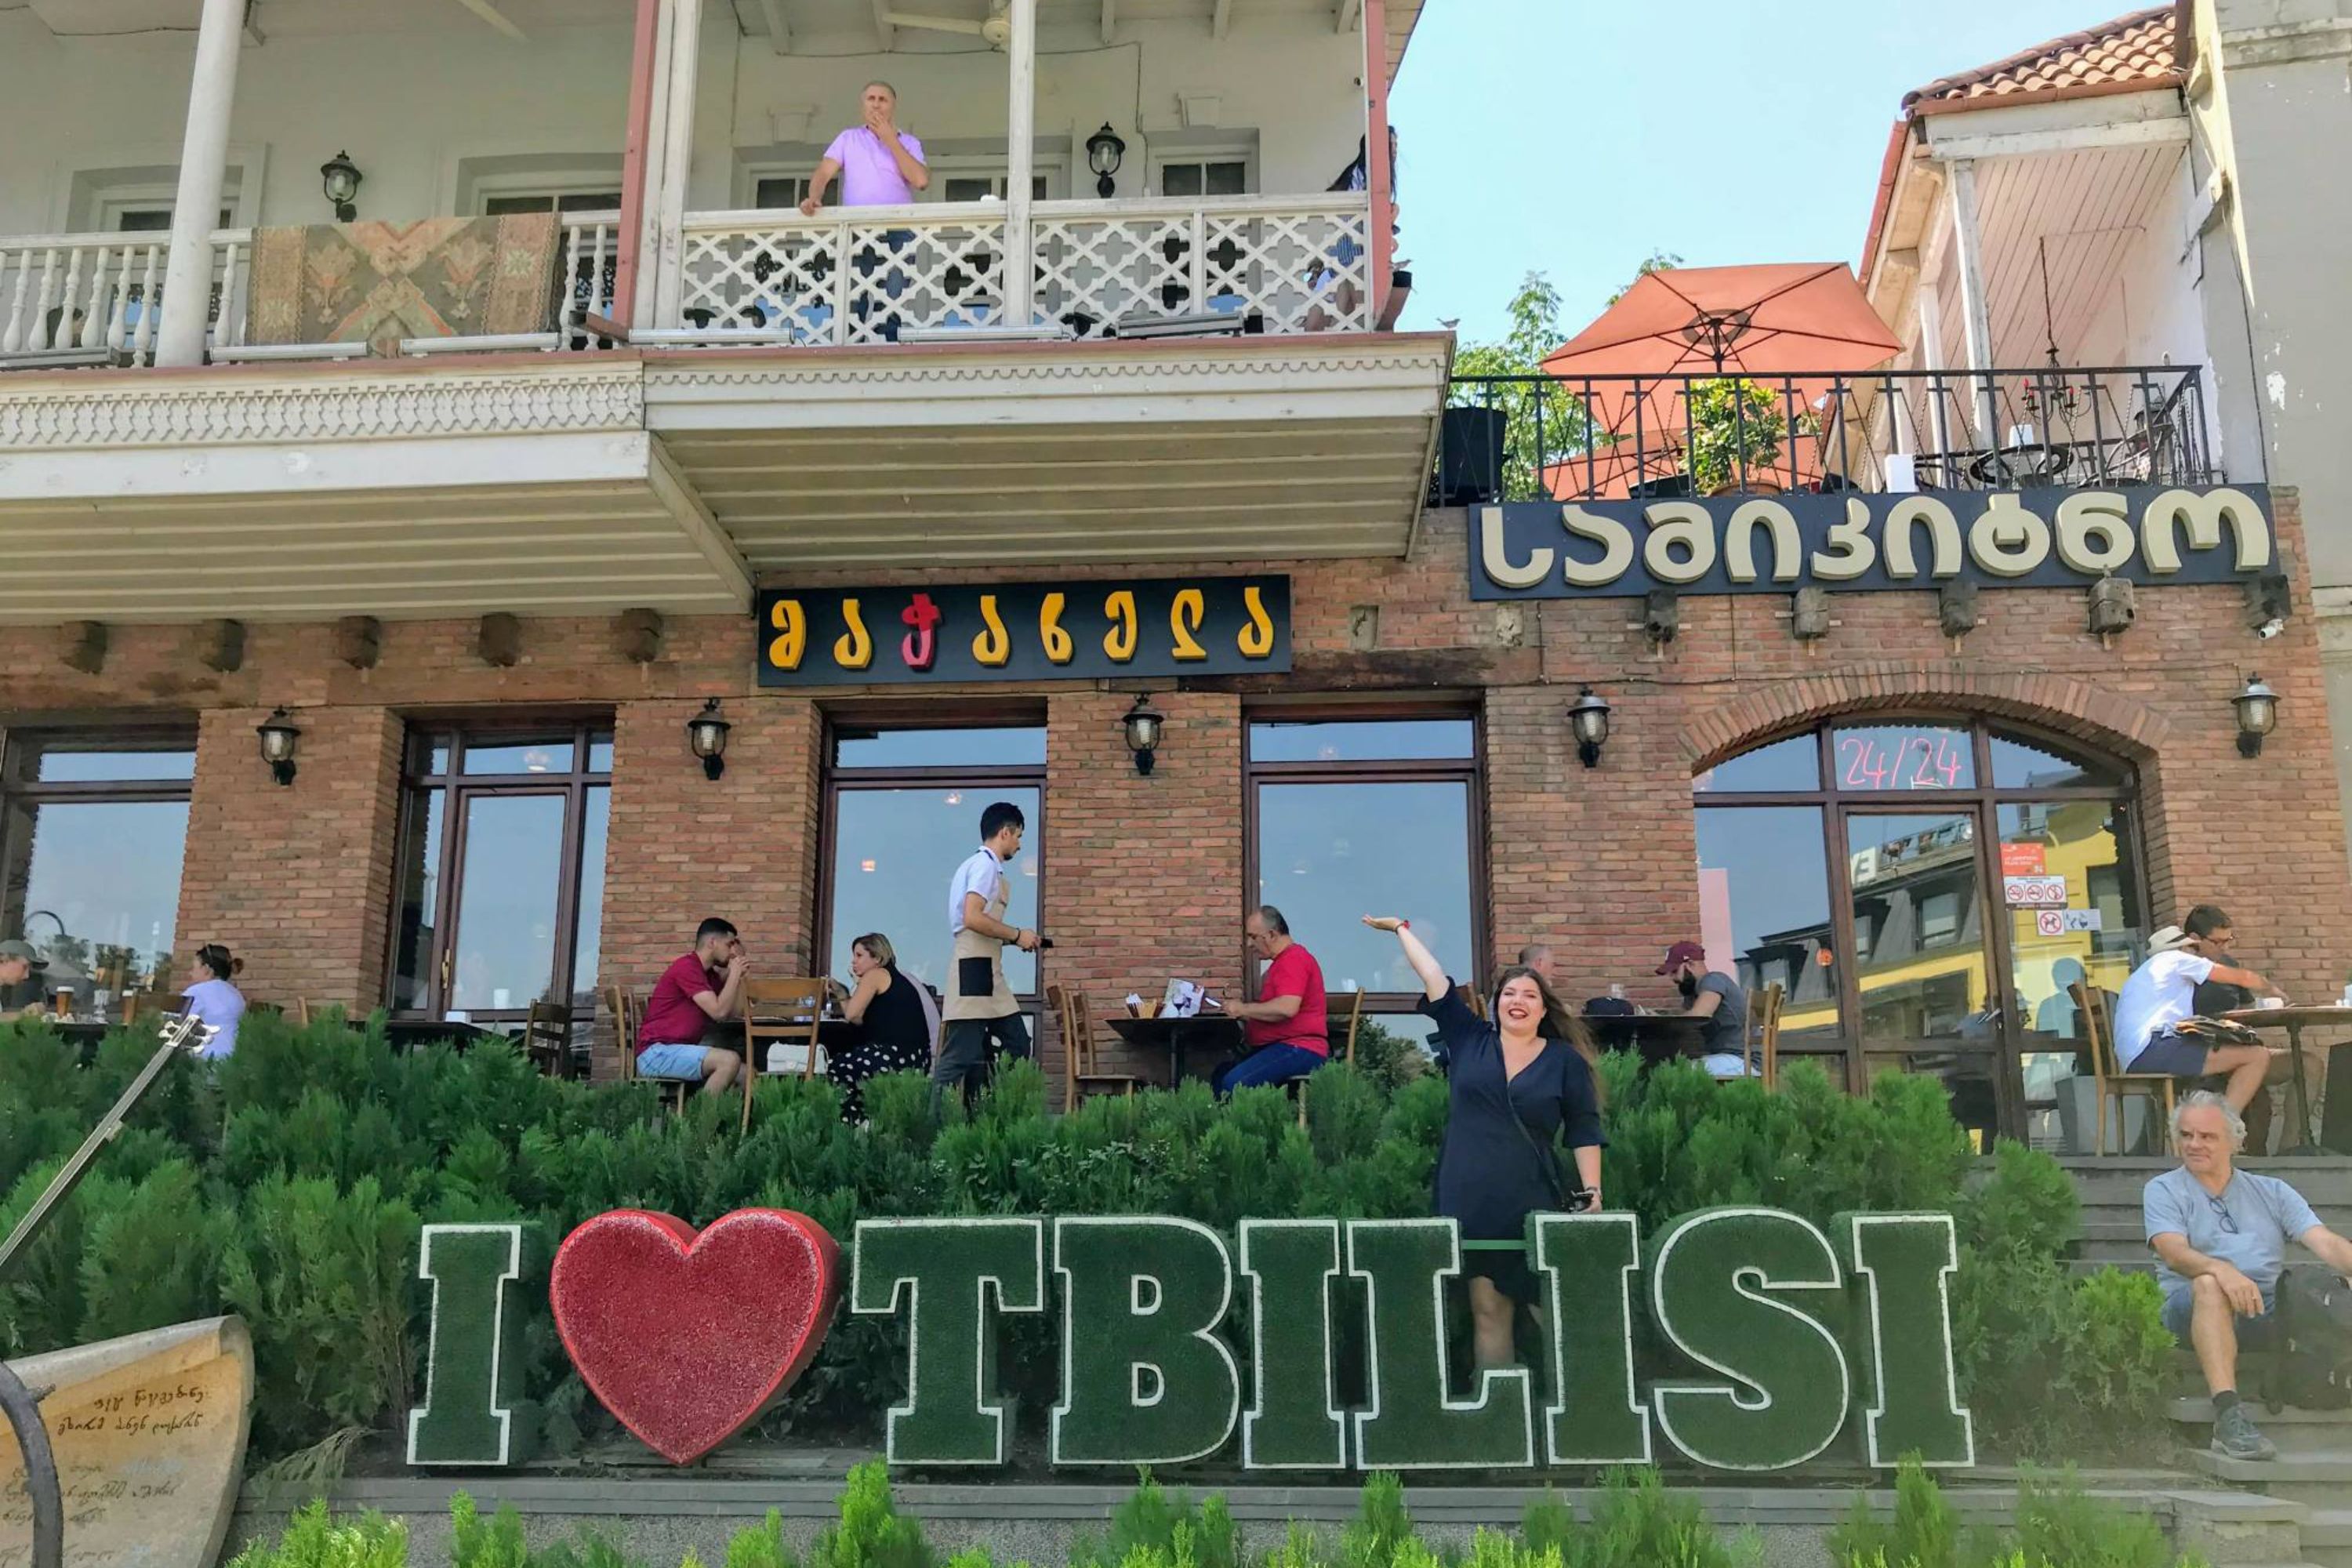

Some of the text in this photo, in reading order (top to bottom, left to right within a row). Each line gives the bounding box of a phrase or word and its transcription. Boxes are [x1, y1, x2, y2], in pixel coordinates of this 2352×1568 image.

[1481, 486, 2270, 590] სამიკიტნო
[768, 586, 1276, 672] მაჭახელა
[1842, 736, 1962, 789] 24/24
[406, 1207, 1976, 1471] I TBILISI
